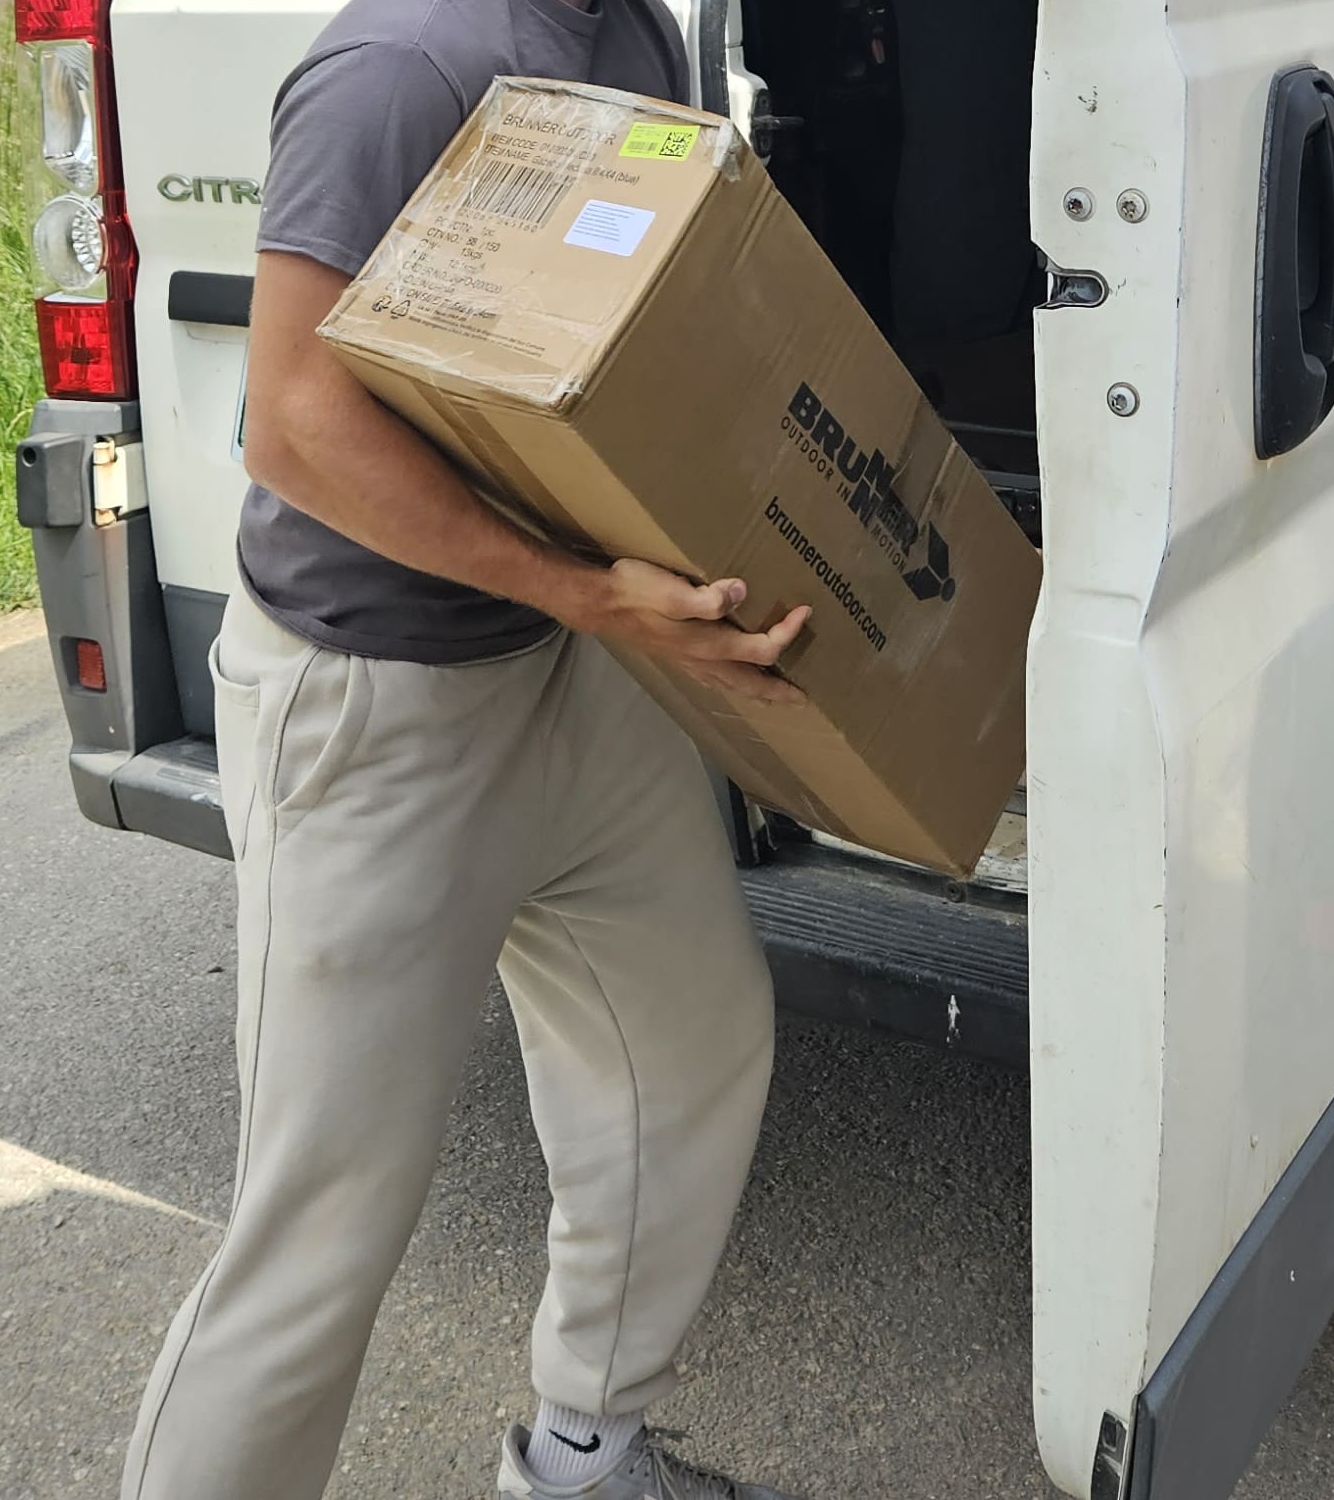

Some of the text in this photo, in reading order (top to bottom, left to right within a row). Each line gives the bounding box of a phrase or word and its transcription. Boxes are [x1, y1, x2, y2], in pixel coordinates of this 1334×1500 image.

[502, 115, 563, 135] BRUNNER
[157, 173, 263, 204] CITR
[780, 416, 907, 574] OUTDOOR IN MOTION
[764, 496, 888, 652] brunneroutdoor.com
